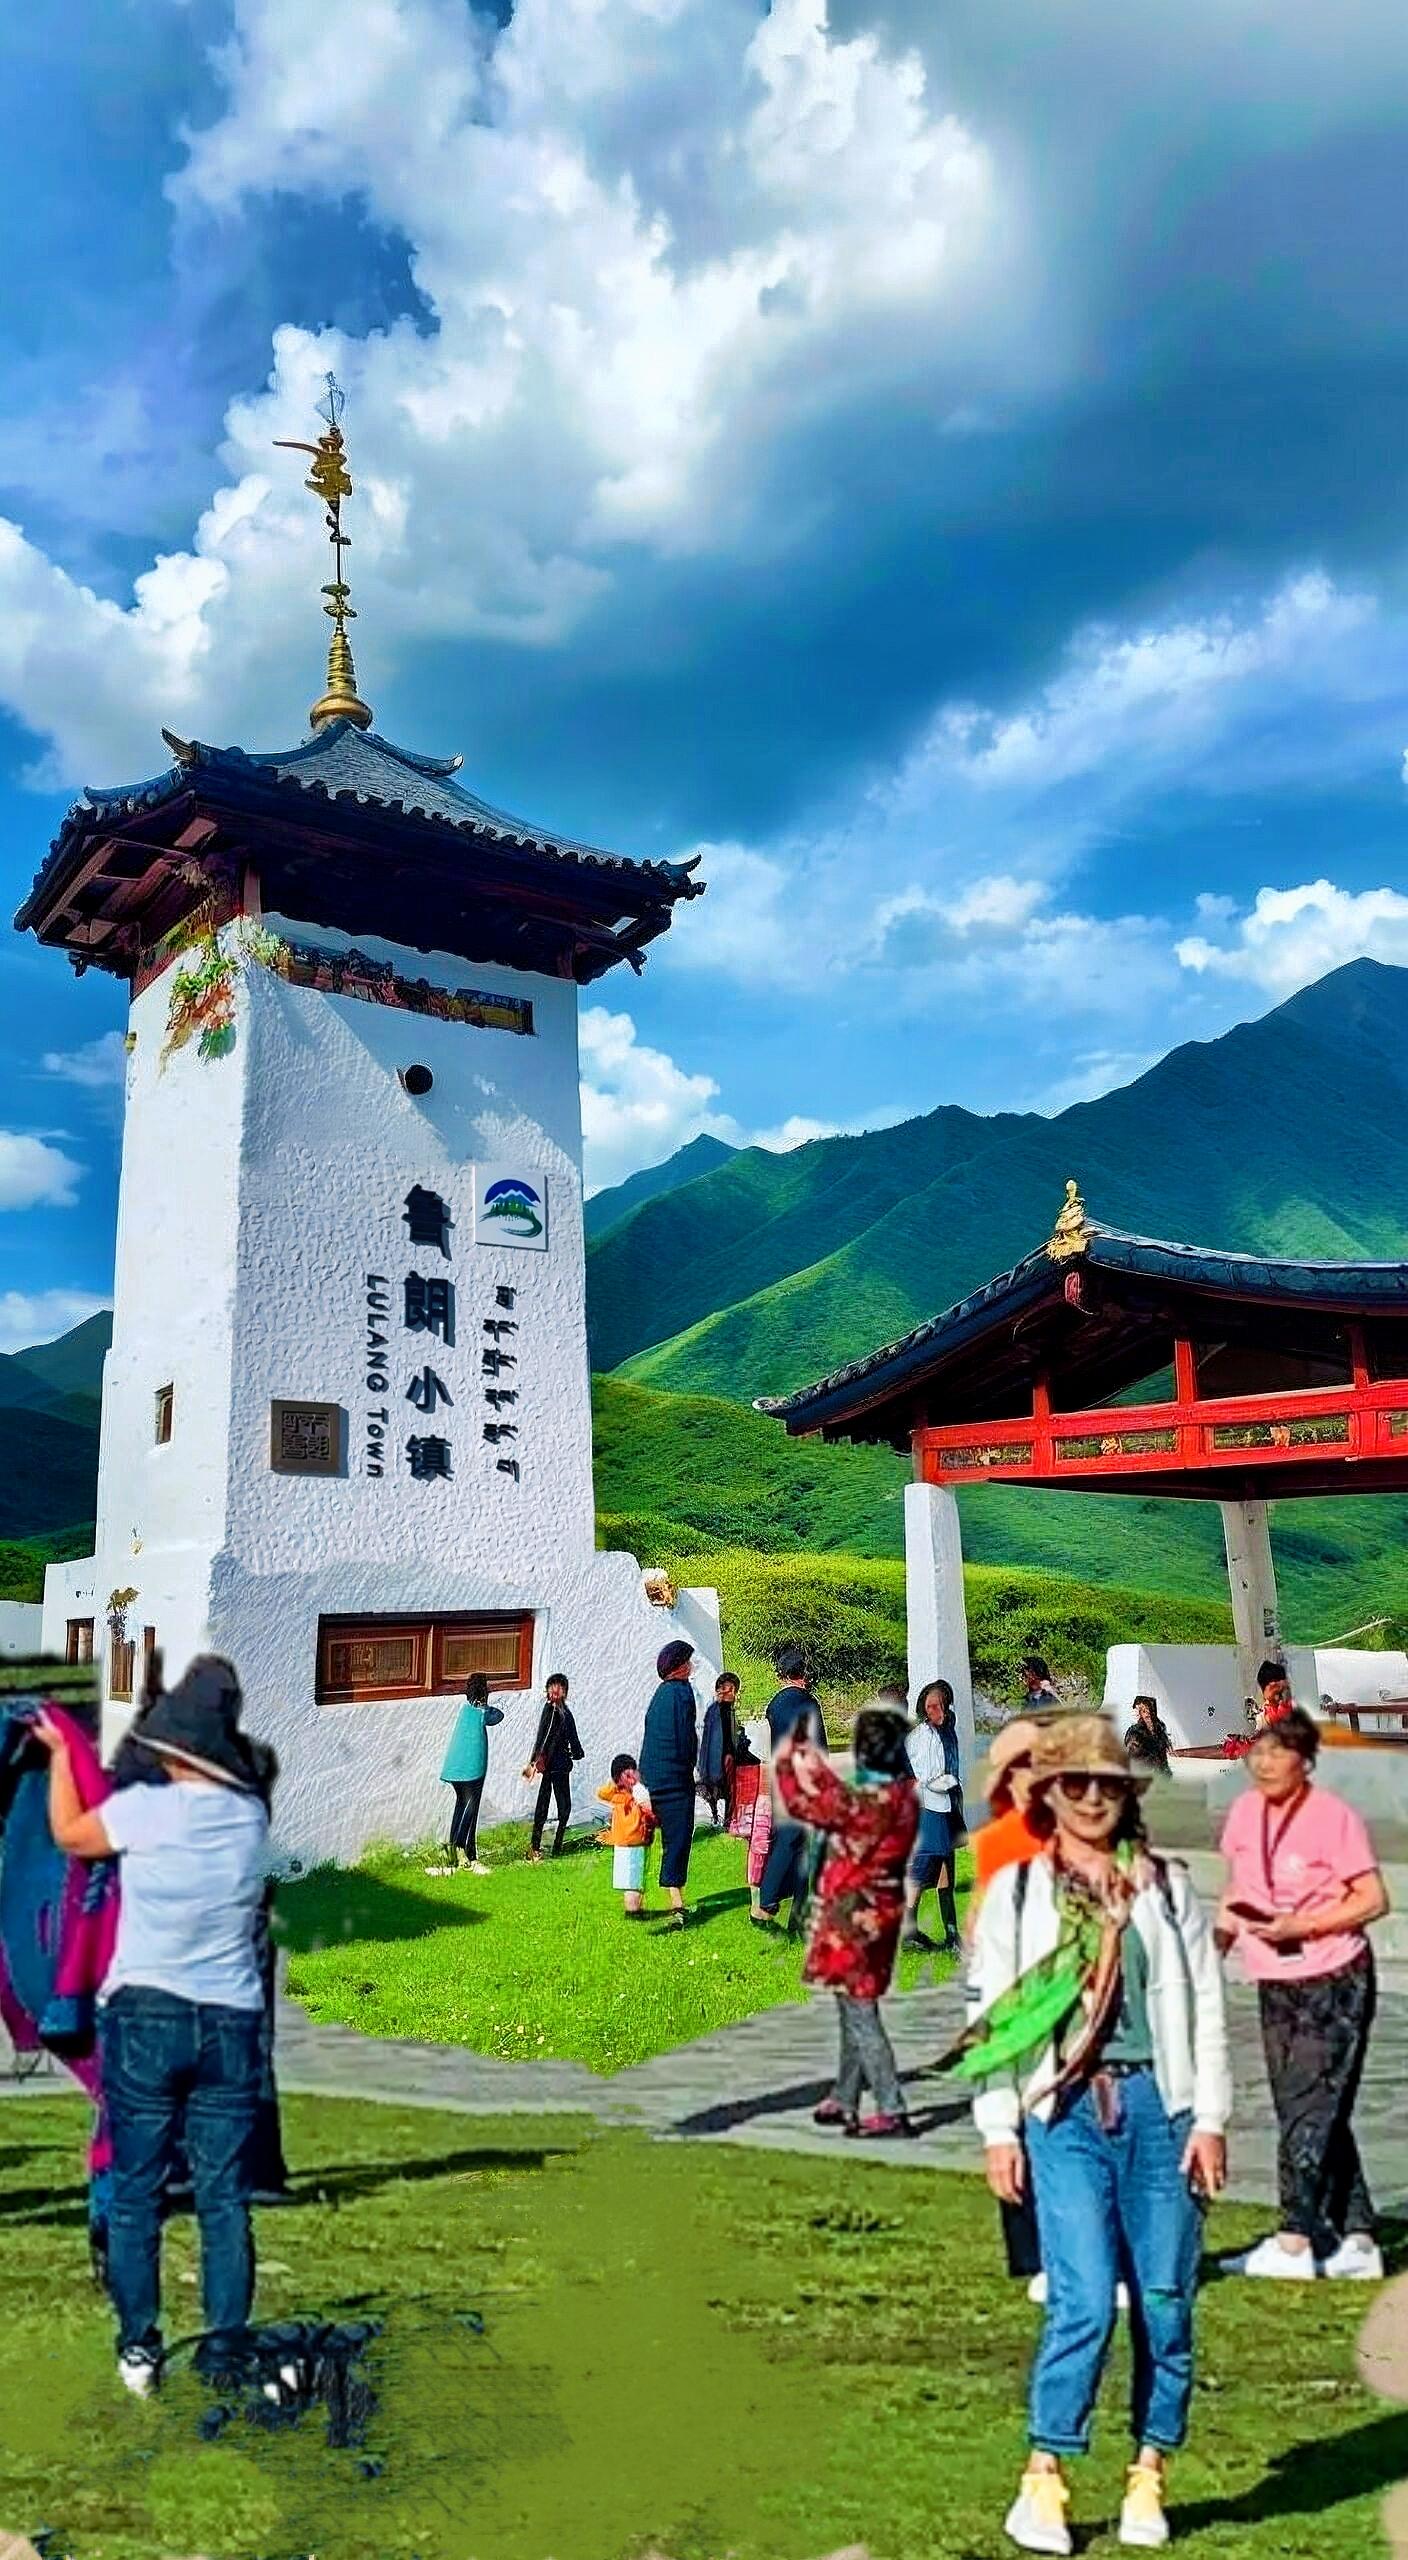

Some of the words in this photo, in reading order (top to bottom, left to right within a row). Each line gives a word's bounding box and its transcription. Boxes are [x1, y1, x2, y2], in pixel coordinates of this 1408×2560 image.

[367, 1275, 388, 1392] LULANG
[402, 1184, 451, 1480] 鲁朗小镇
